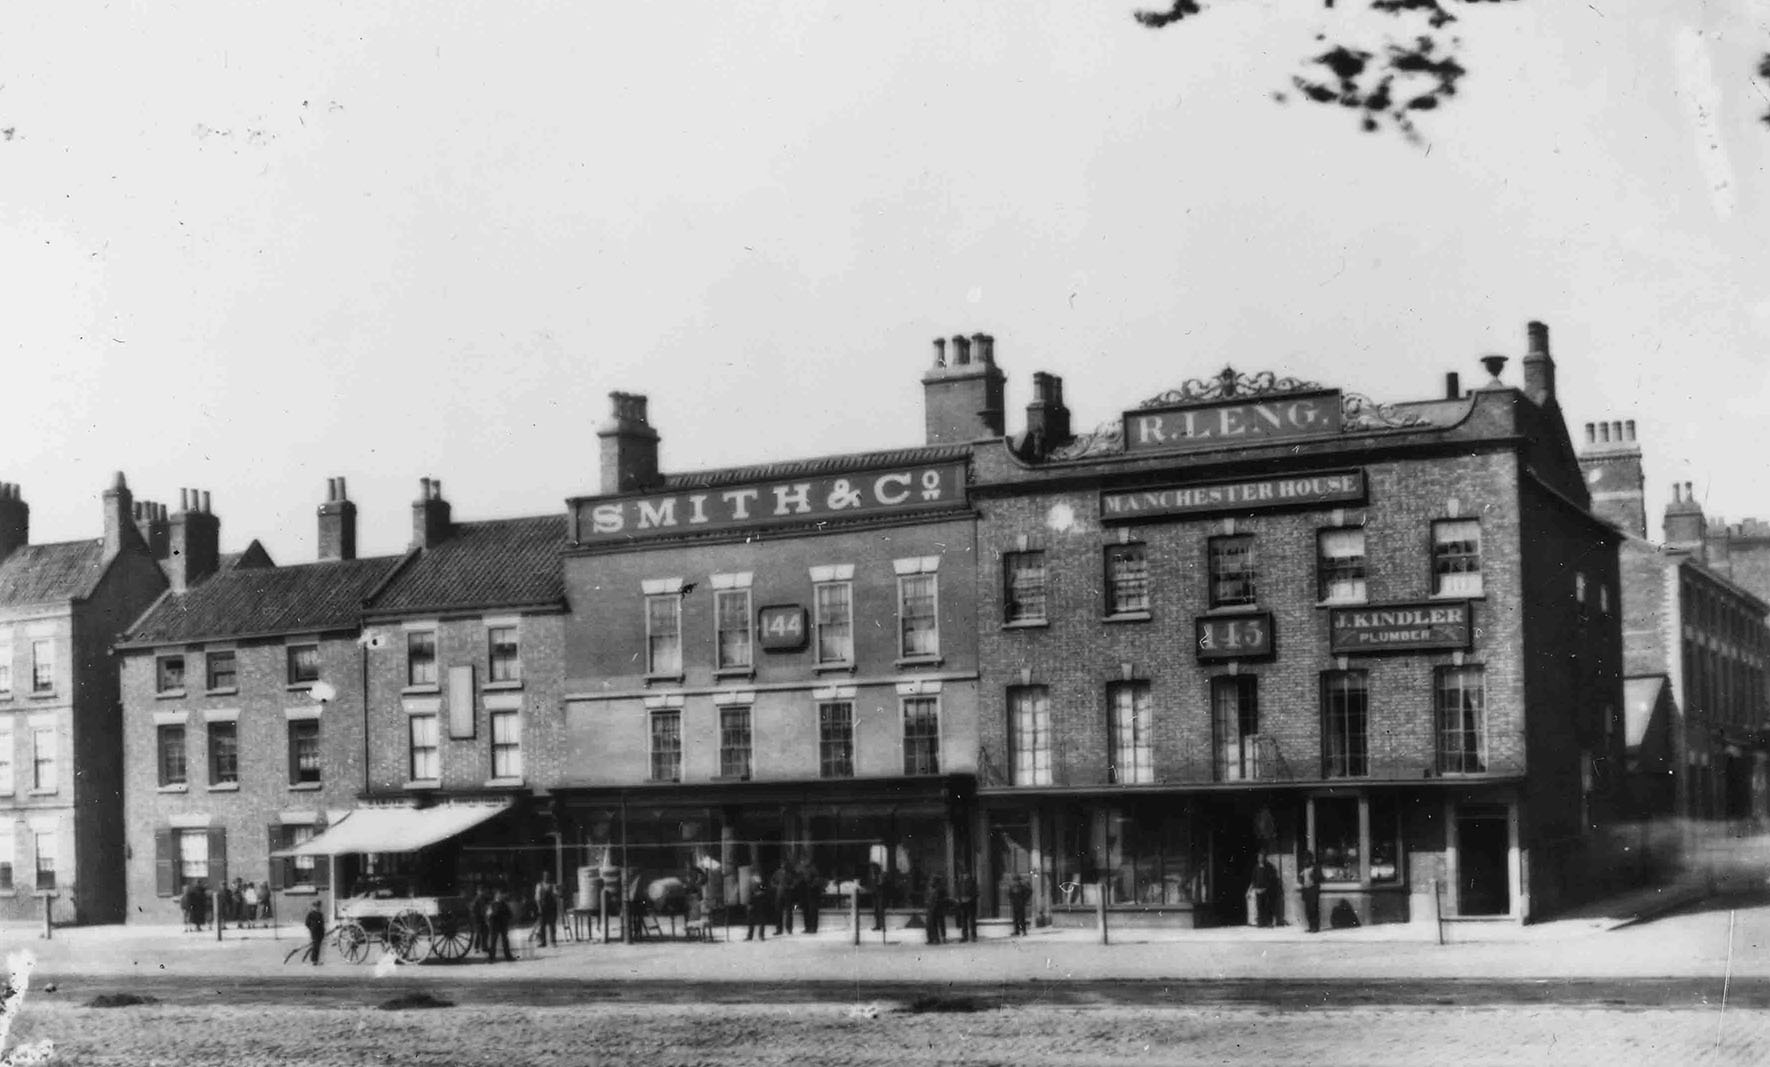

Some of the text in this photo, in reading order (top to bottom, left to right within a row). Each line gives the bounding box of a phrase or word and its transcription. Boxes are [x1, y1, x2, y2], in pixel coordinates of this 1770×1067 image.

[592, 483, 812, 533] SMITH
[827, 478, 862, 510] &
[1104, 475, 1357, 513] MANCHESTER HOUSE
[762, 614, 801, 637] 144
[1360, 630, 1431, 643] PLUMBER
